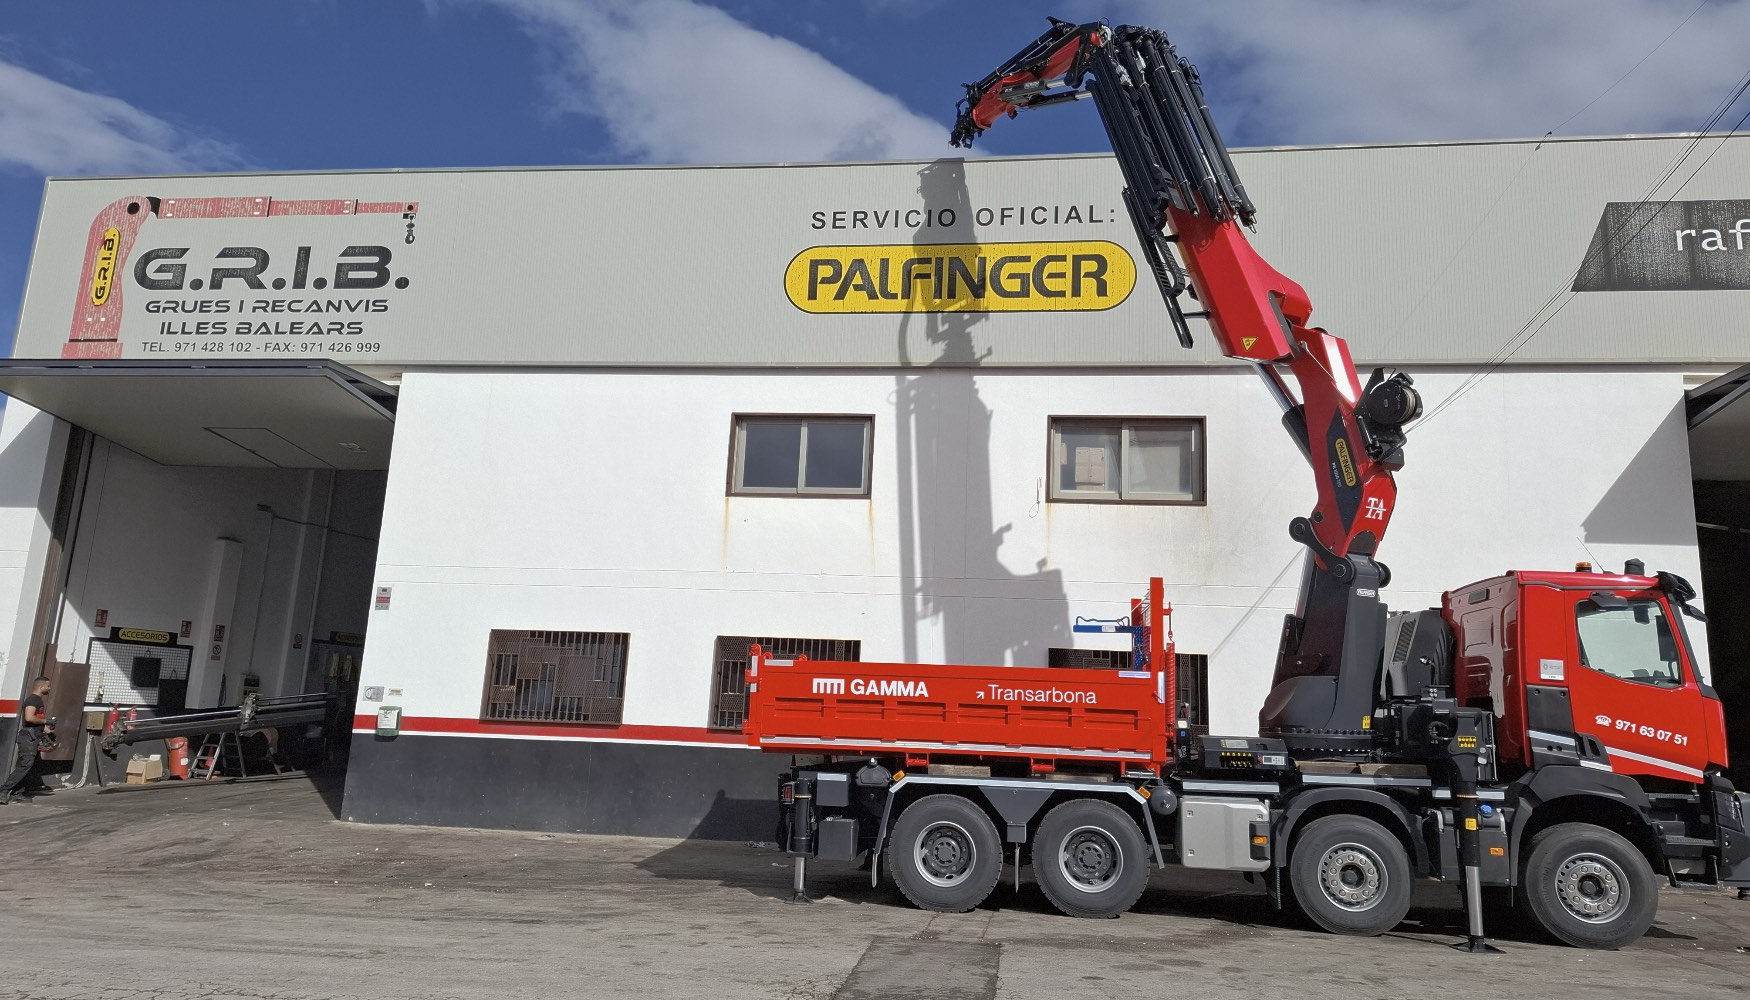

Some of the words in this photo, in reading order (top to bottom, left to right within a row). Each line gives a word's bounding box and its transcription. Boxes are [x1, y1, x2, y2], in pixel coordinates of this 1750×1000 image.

[811, 208, 957, 230] SERVICIO
[975, 204, 1117, 226] OFICIAL:
[133, 246, 410, 291] G.R.I.B.
[807, 254, 1109, 301] PALFINGER
[145, 300, 231, 314] GRUES
[238, 300, 245, 313] I
[251, 299, 389, 313] RECANVIS
[160, 321, 228, 335] ILLES
[235, 321, 364, 335] BALEARS
[142, 341, 170, 353] TEL.
[174, 342, 197, 353] 971
[201, 342, 224, 353] 428
[229, 342, 252, 353] 102
[264, 342, 296, 353] FAX:
[300, 342, 323, 353] 971
[328, 342, 352, 353] 426
[356, 342, 381, 353] 999
[1337, 441, 1354, 484] PALFINGER
[1365, 497, 1386, 520] TA
[121, 630, 168, 641] ACCESORIOS
[850, 679, 929, 698] GAMMA
[987, 684, 1097, 704] Transarbona
[1615, 719, 1637, 734] 971
[1639, 725, 1655, 738] 63
[1656, 730, 1672, 742] 07
[1673, 734, 1688, 746] 51
